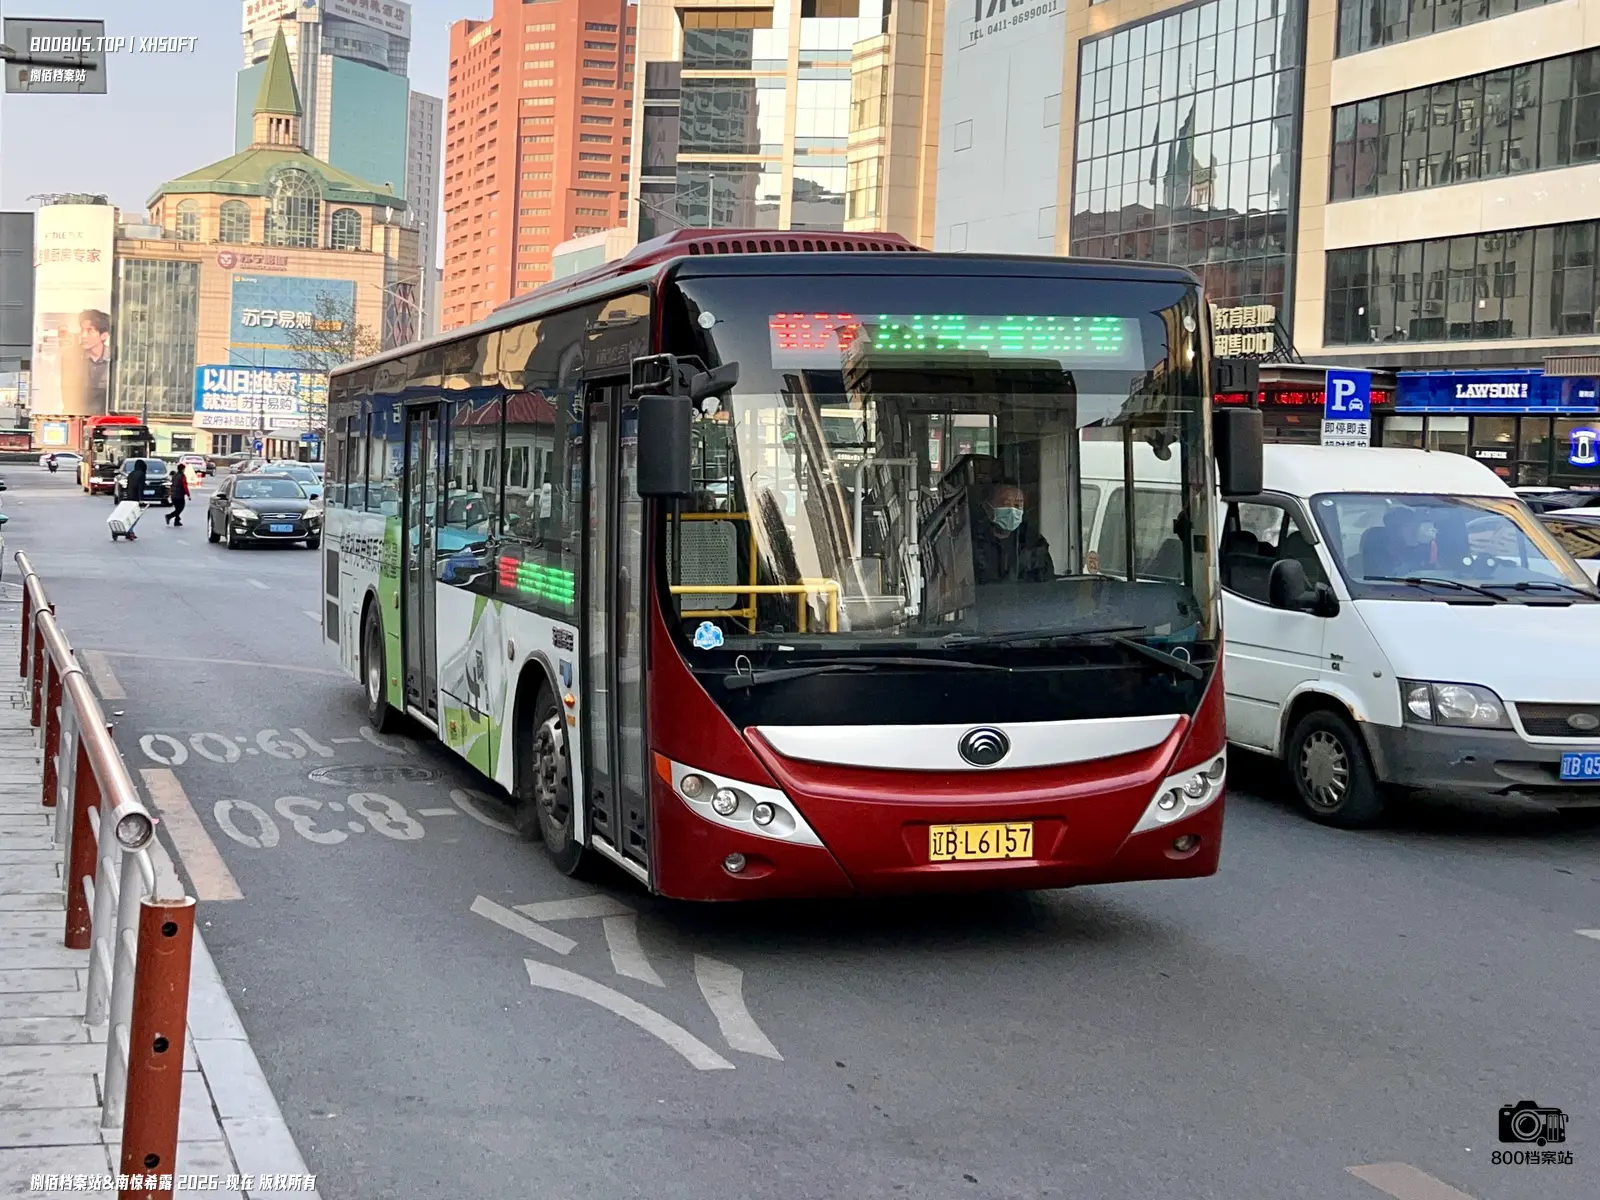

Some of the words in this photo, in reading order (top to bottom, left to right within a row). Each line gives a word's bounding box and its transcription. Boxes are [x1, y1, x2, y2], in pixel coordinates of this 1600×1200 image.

[969, 28, 984, 42] TEL
[987, 0, 1057, 35] 0411-86990011
[241, 308, 314, 330] 苏宁易购
[1215, 304, 1276, 330] 教育基地
[203, 368, 297, 395] 以旧换新
[1455, 383, 1521, 398] LAWSON
[242, 397, 293, 411] 苏宁易购
[1331, 379, 1356, 411] P
[1324, 422, 1367, 435] 即停即走
